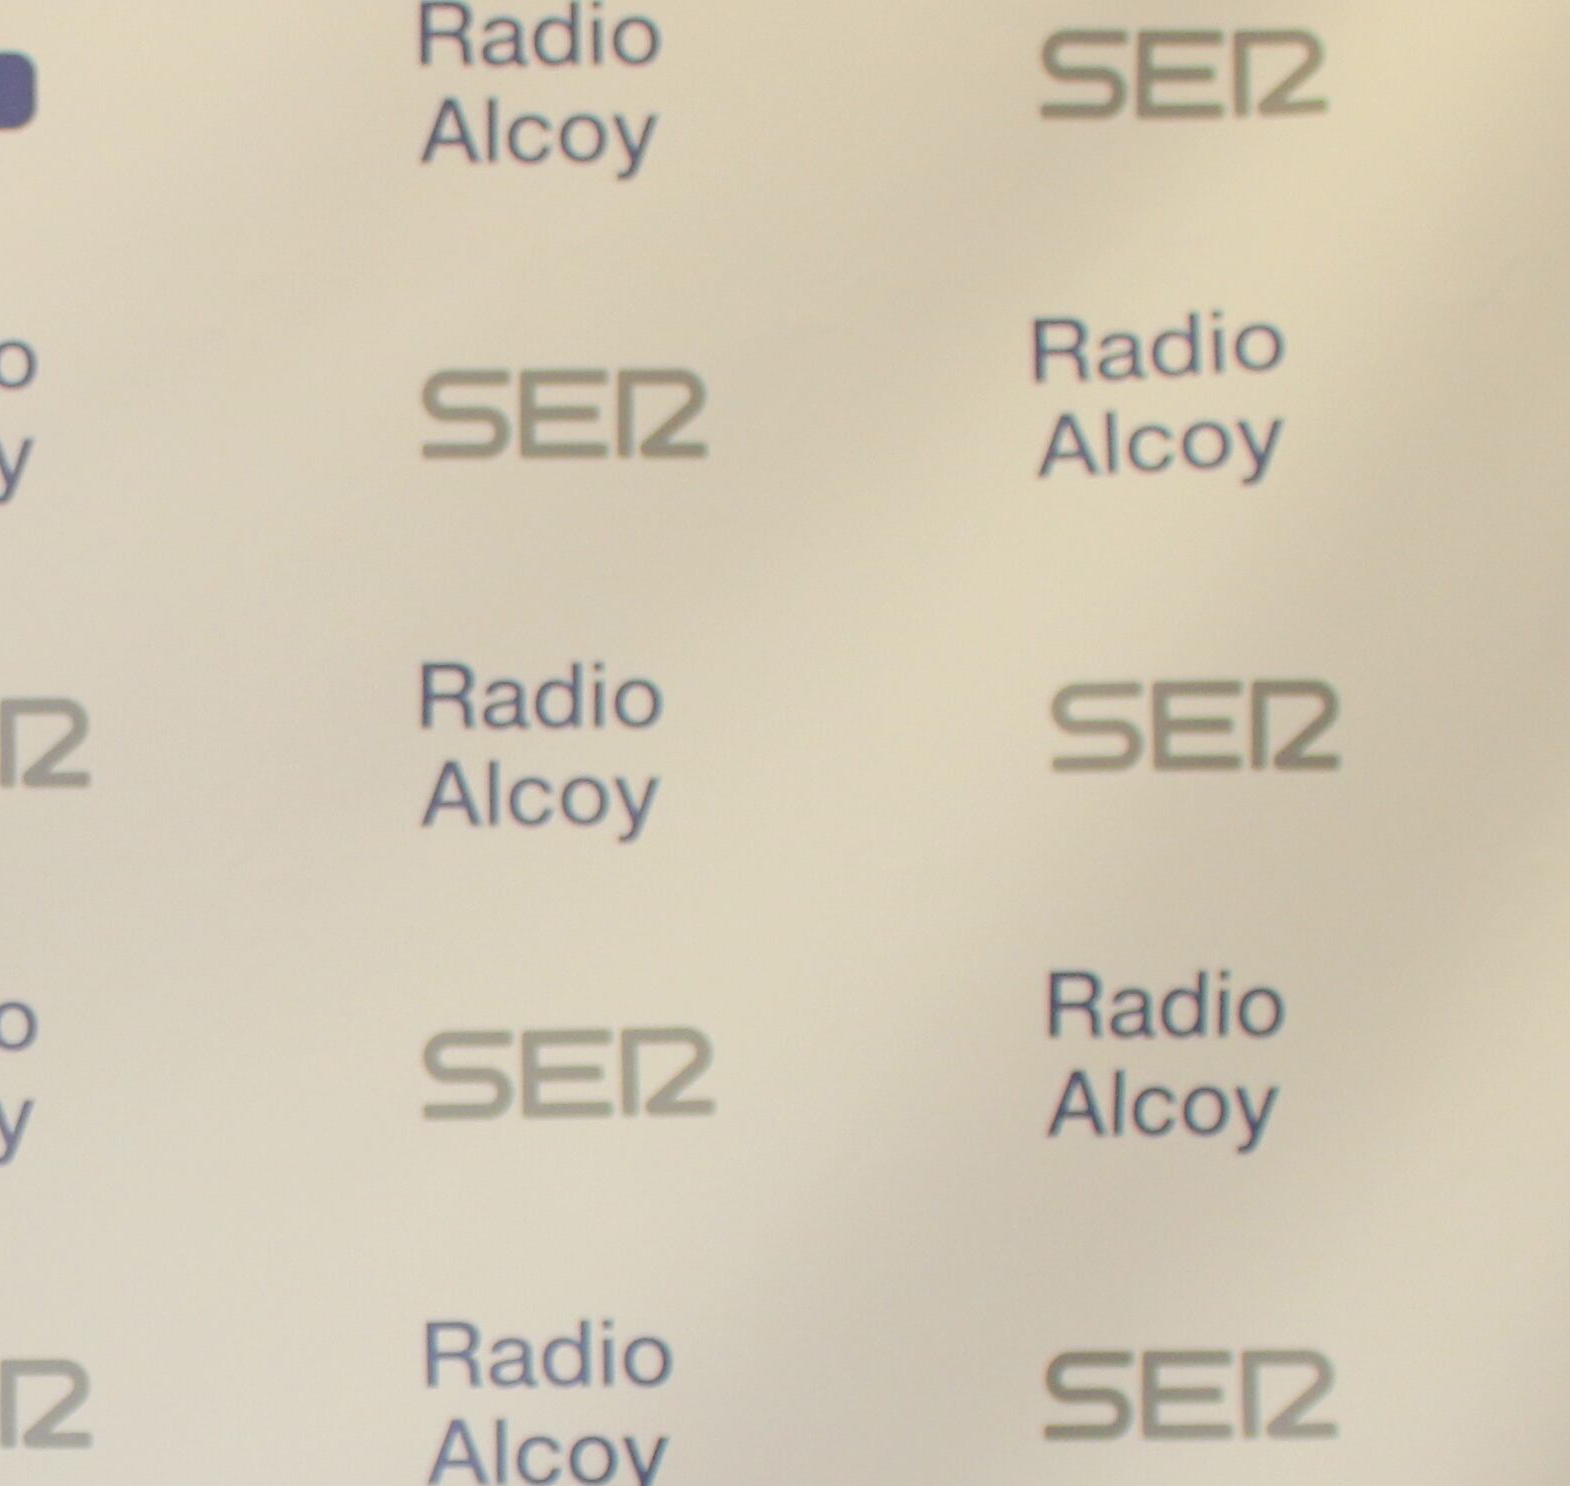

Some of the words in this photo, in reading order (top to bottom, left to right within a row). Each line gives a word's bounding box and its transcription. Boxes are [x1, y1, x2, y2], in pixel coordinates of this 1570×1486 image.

[419, 0, 660, 67] Radio
[1039, 28, 1327, 120] SER
[420, 97, 657, 181] Alcoy
[1032, 311, 1284, 383] Radio
[421, 368, 707, 460] SER
[1037, 411, 1282, 486] Alcoy
[420, 662, 662, 730] Radio
[1050, 679, 1340, 772] SER
[421, 760, 658, 843] Alcoy
[1048, 970, 1284, 1039] Radio
[422, 1026, 715, 1120] SER
[1047, 1069, 1278, 1154] Alcoy
[425, 1319, 672, 1388] Radio
[1043, 1349, 1337, 1441] SER
